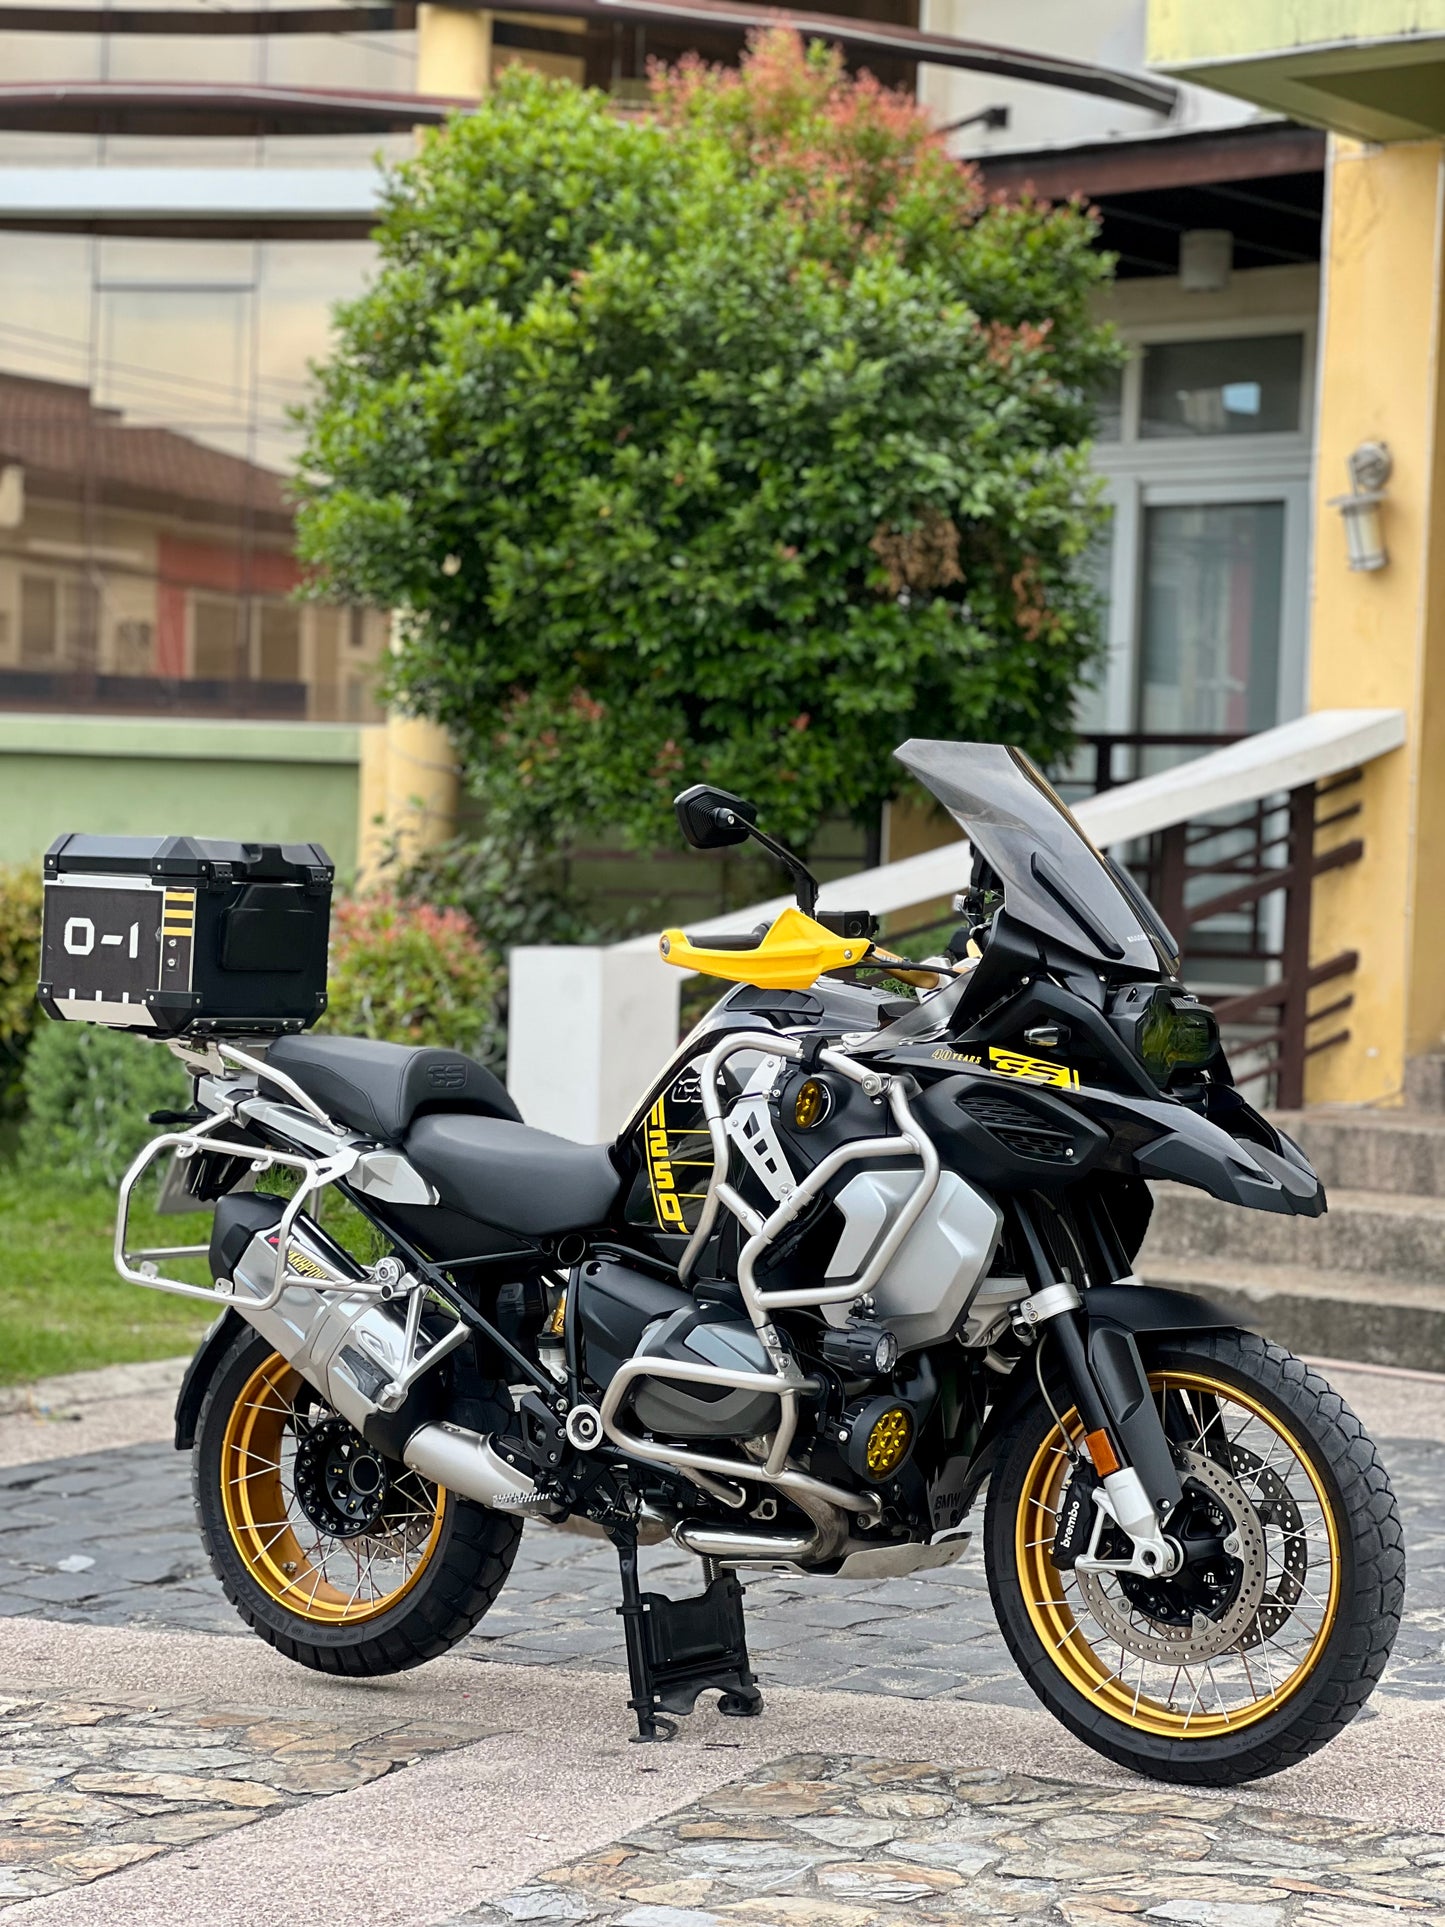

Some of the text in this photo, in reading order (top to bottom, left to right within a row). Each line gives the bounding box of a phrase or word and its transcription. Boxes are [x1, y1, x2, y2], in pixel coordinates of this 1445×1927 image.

[931, 1048, 982, 1065] 40 YEARS
[934, 1492, 961, 1510] BMW
[1060, 1500, 1081, 1549] brembo
